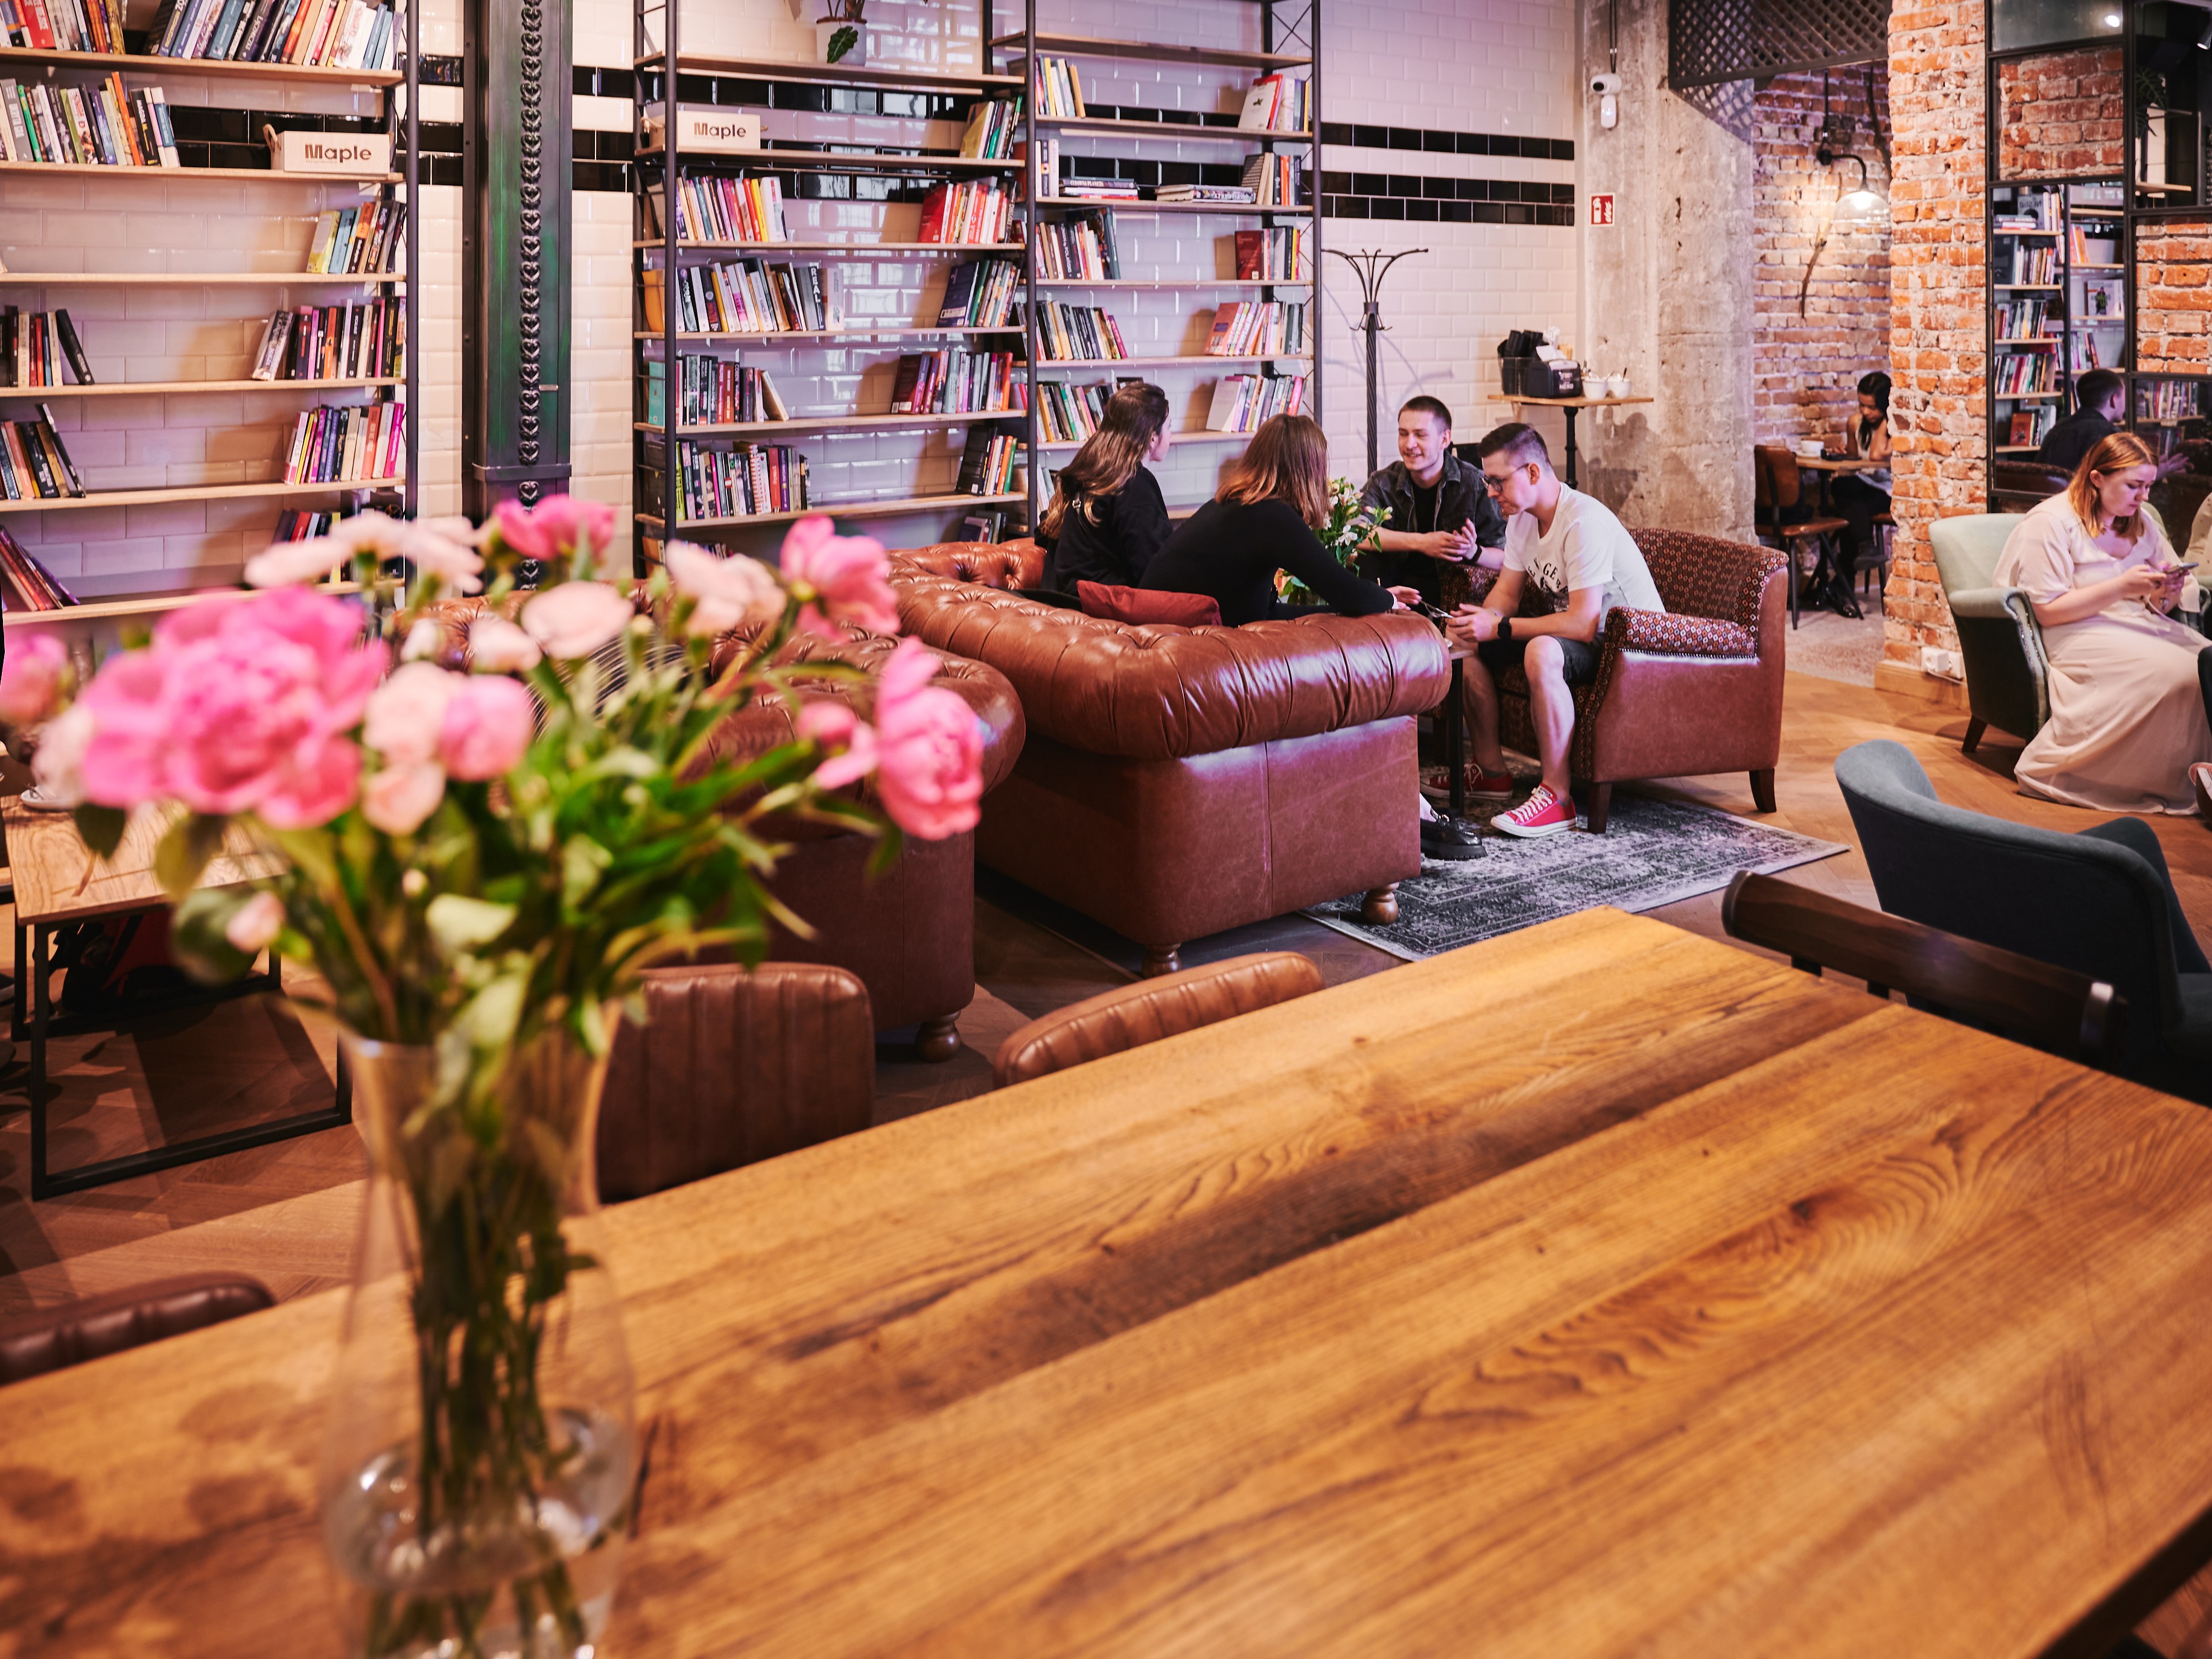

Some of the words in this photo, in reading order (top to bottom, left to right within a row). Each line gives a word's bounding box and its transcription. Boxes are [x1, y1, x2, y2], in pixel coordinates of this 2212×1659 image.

[694, 122, 746, 139] Maple
[305, 144, 372, 163] Maple
[810, 267, 821, 303] REAL
